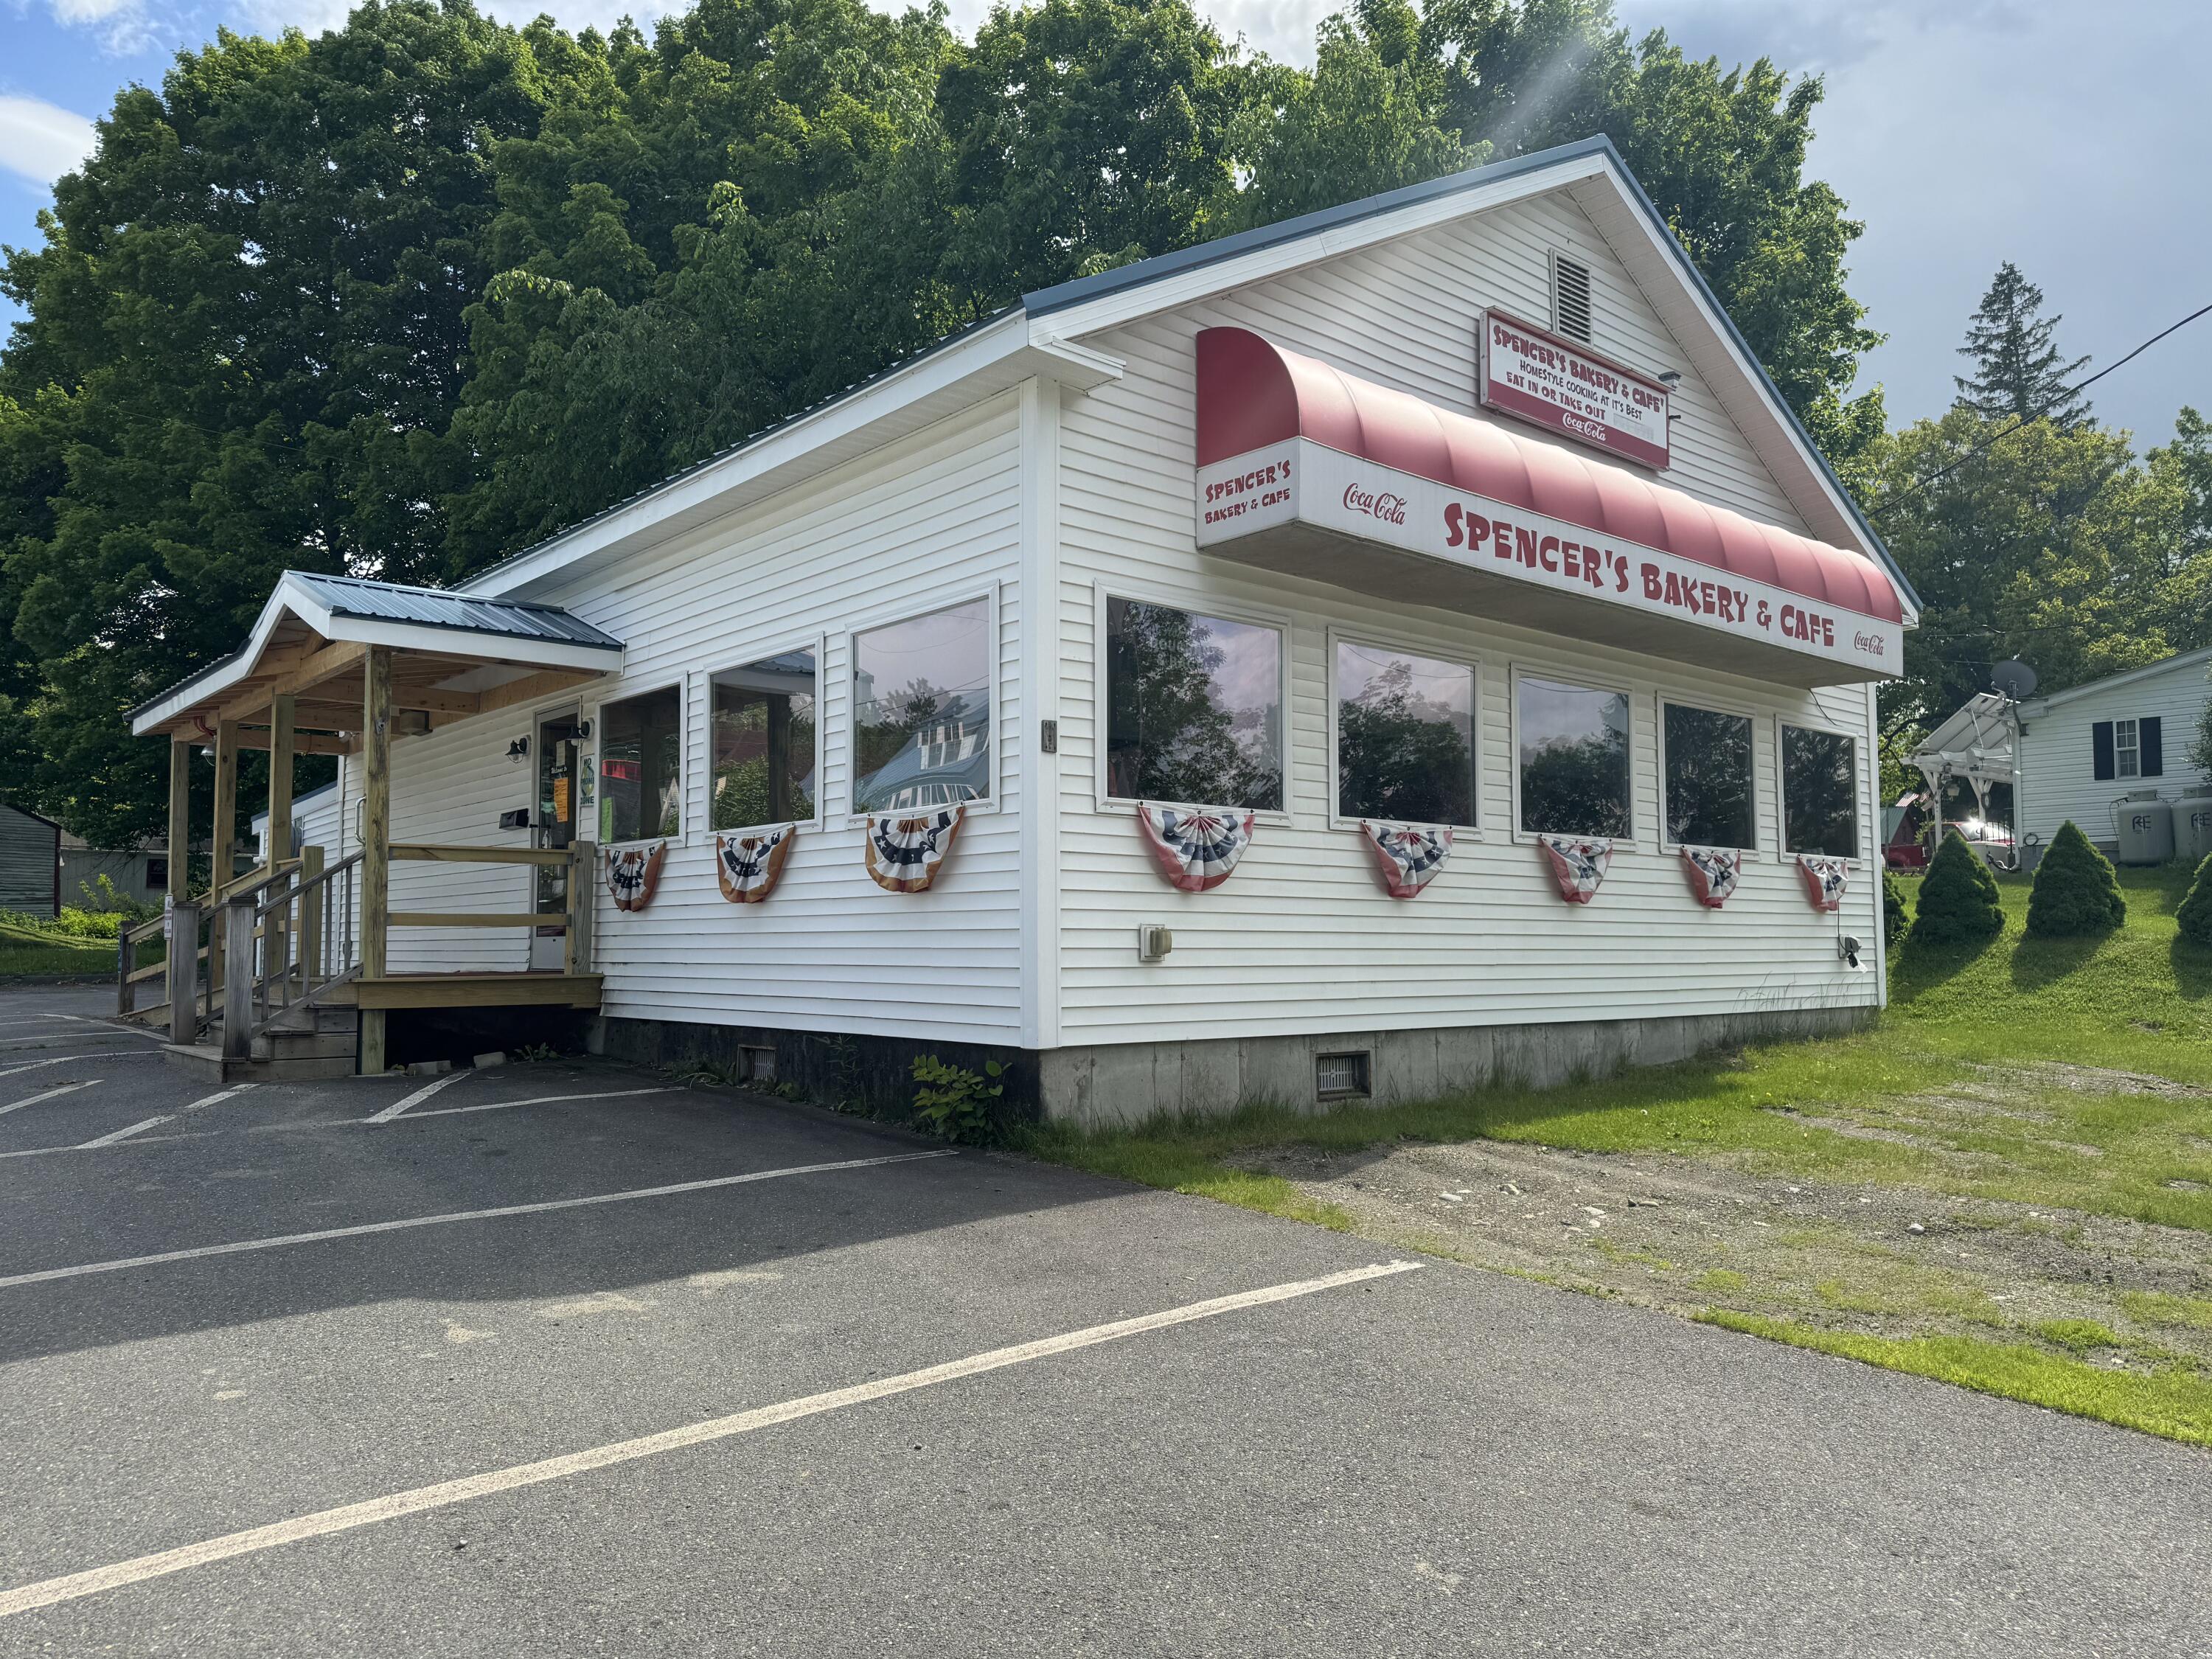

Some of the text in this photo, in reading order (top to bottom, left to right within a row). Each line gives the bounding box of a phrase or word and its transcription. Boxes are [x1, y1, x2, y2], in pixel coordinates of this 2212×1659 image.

[1493, 324, 1566, 373] SPENCER'S
[1569, 359, 1619, 394] BAKERY
[1621, 383, 1630, 400] &
[1506, 371, 1606, 420] EAT IN OR TAKE OUT
[1520, 359, 1643, 421] HOMESTYLE COOKING AT IT'S BEST
[1205, 487, 1290, 524] BAKERY & CAFE
[1206, 459, 1291, 504] SPENCER'S
[1444, 503, 1835, 647] SPENCER'S BAKERY & CAFE
[583, 758, 592, 767] NO
